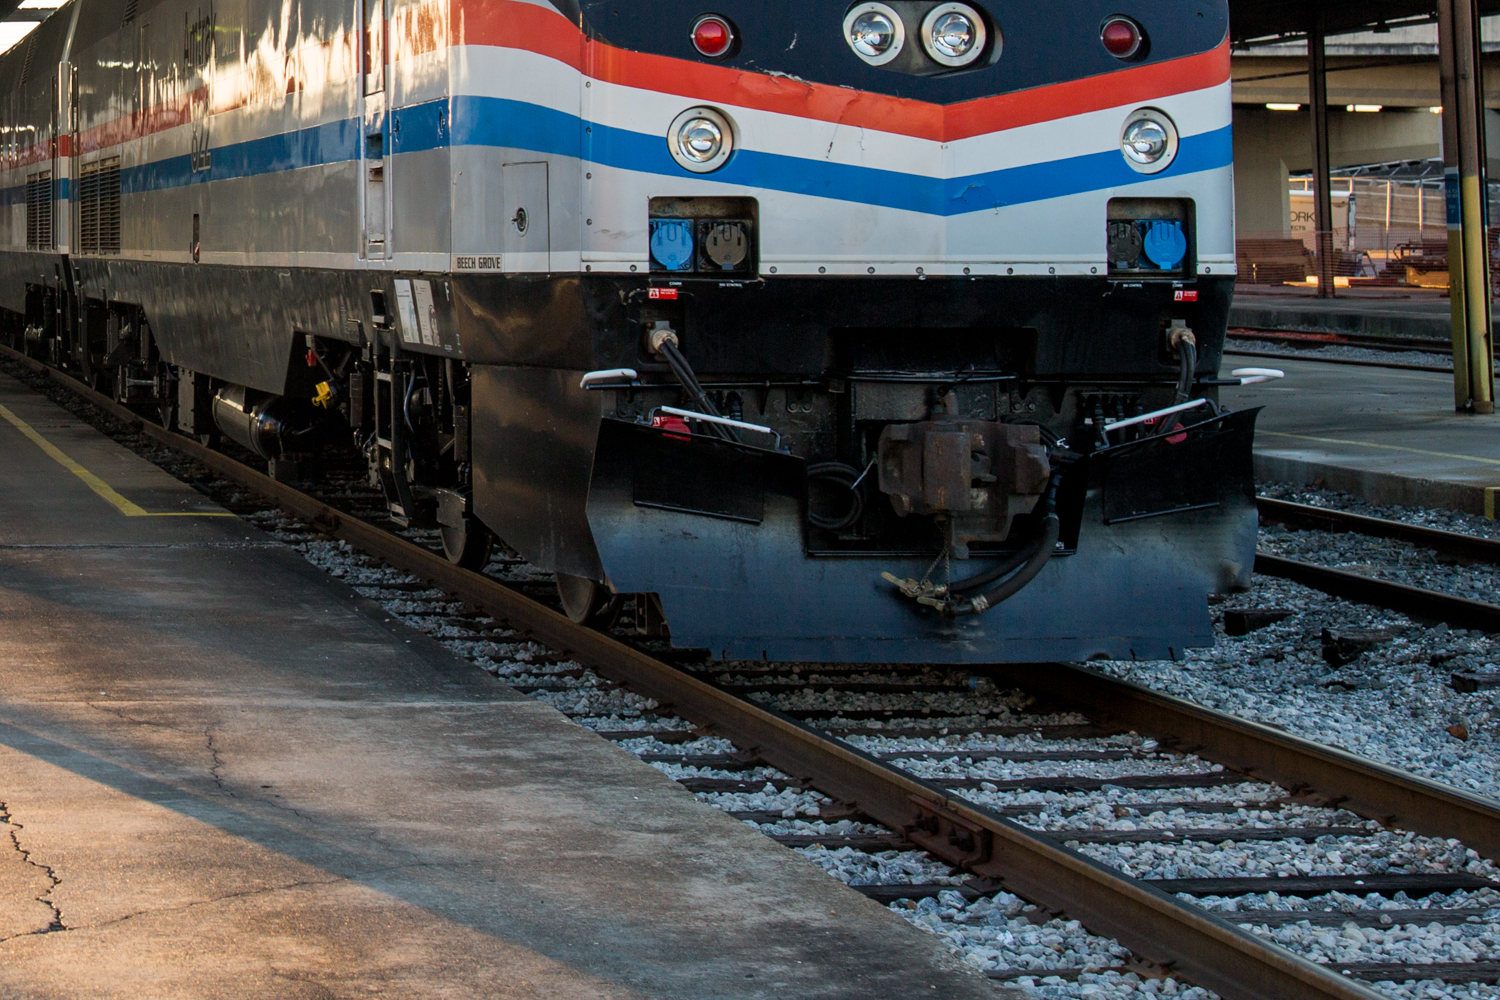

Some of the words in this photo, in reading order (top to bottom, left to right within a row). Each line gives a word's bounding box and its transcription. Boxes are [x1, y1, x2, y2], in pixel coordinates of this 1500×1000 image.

[1290, 210, 1316, 222] ORK
[457, 257, 476, 269] BEECH
[478, 257, 501, 269] GROVE
